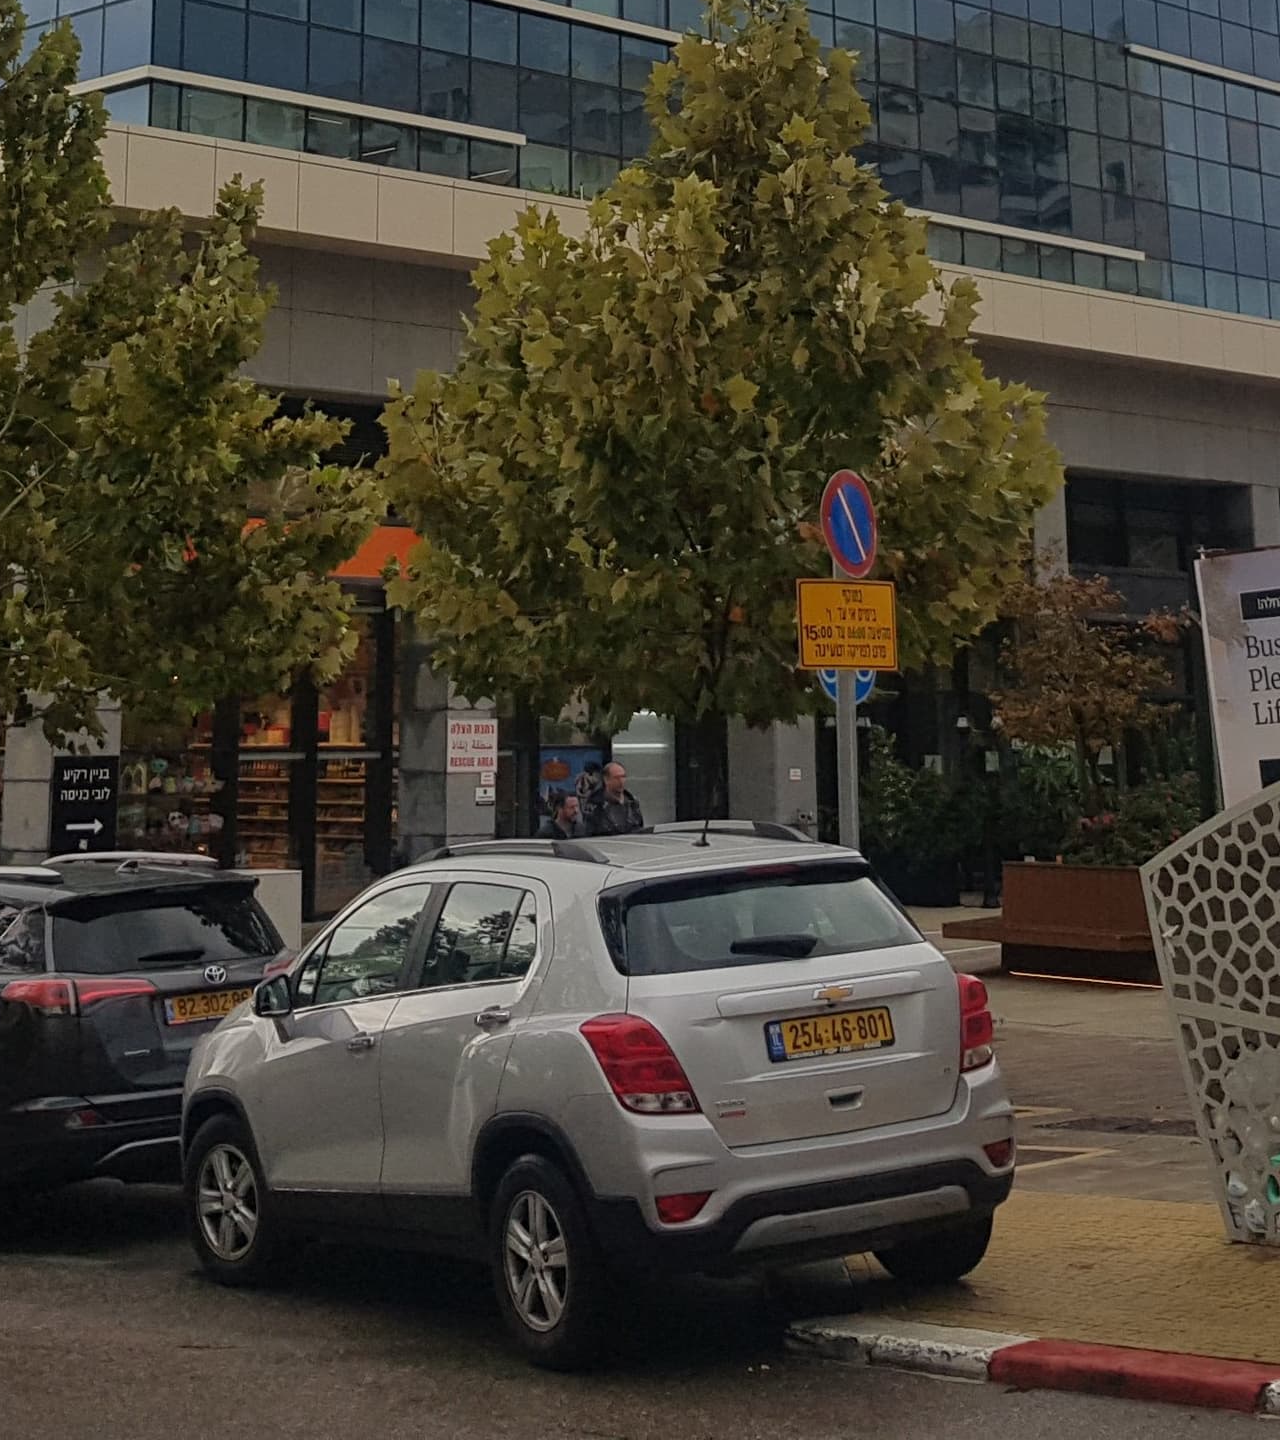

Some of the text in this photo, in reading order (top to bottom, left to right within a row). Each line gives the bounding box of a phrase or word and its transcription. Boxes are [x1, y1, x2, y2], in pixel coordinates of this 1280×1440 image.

[803, 624, 833, 641] 15:00
[450, 756, 494, 767] RESCUE AREA
[63, 768, 110, 783] בניין רקיע
[60, 786, 111, 801] לובי כניסה
